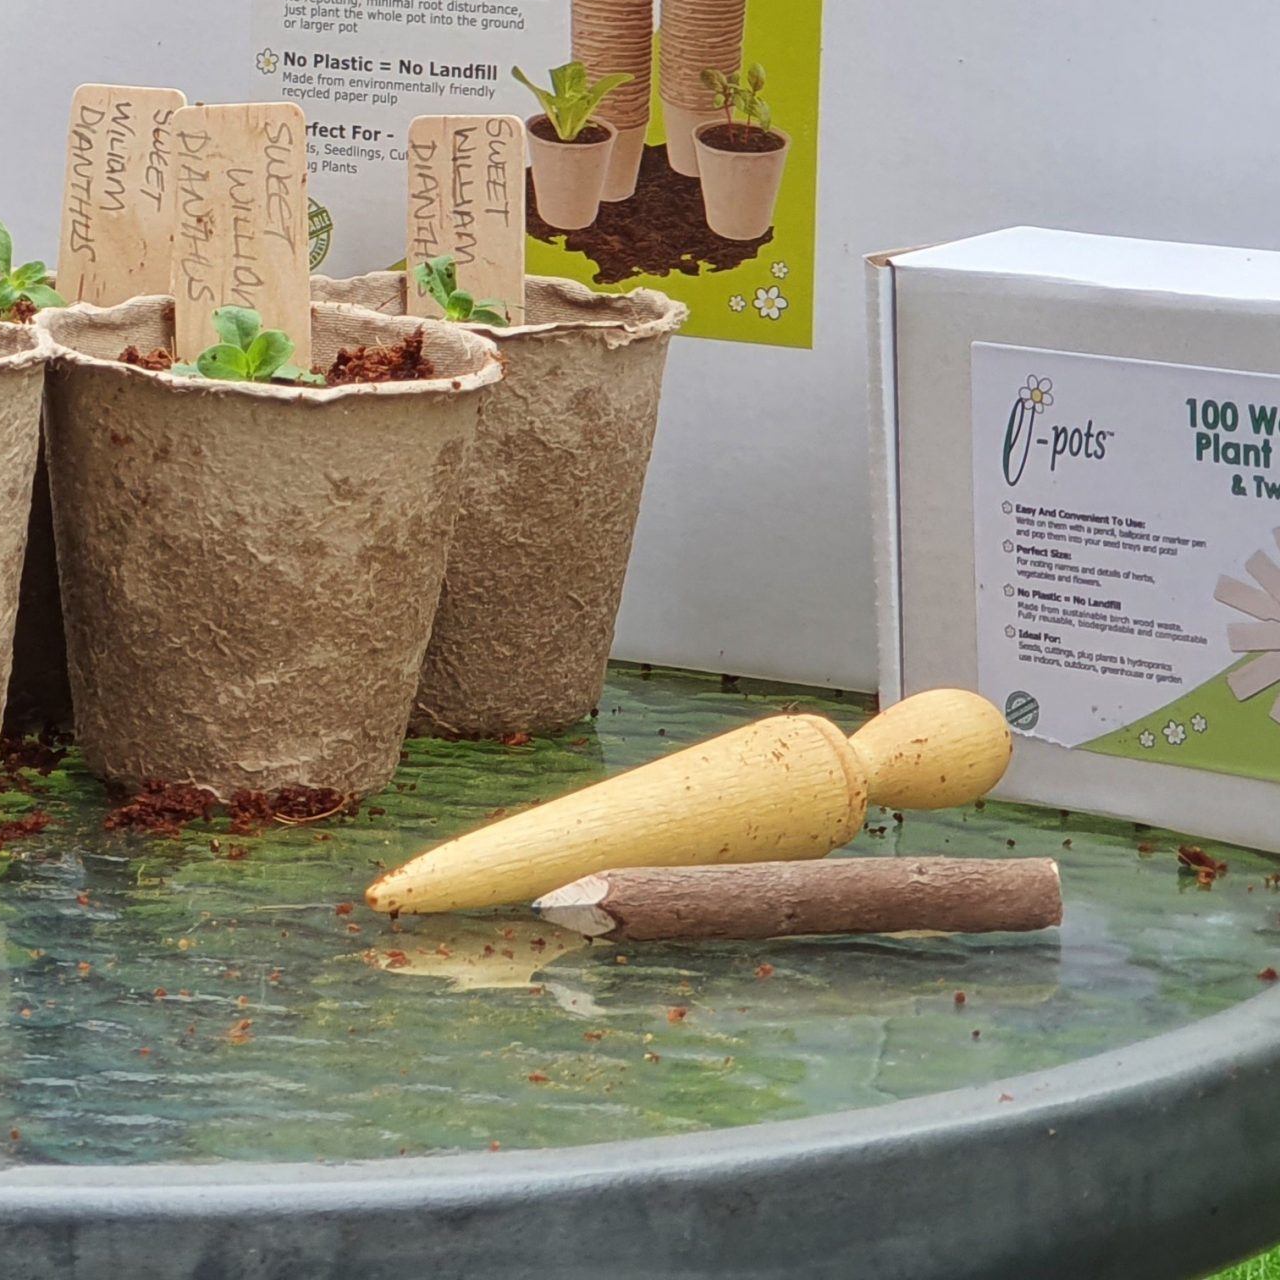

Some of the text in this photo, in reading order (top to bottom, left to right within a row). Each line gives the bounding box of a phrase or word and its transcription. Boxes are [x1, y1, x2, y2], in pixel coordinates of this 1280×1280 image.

[283, 4, 525, 30] just plant the whole pot into the ground
[418, 0, 443, 11] root
[446, 0, 522, 17] disturbance,
[283, 18, 358, 34] or larger pot
[283, 51, 497, 81] No Plastic = No Landfill
[281, 87, 398, 106] recycled paper pulp
[282, 71, 495, 100] Made from environmentally friendly
[304, 121, 347, 140] rfect
[351, 125, 382, 142] For
[140, 108, 174, 212] SWEET
[324, 143, 386, 161] Seedlings,
[321, 160, 359, 175] Plants
[484, 119, 514, 228] SWEET
[68, 105, 106, 263] DIANTHUS
[263, 122, 297, 255] SWEET
[176, 130, 215, 301] DIANTHUS
[411, 140, 439, 297] DIANTH
[1185, 398, 1239, 433] 100
[1196, 431, 1273, 469] Plant
[1231, 473, 1248, 497] &
[1015, 503, 1037, 517] Easy
[1038, 506, 1057, 518] And
[1058, 509, 1110, 522] Convenient
[1111, 515, 1124, 527] To
[1016, 544, 1048, 557] Perfect
[1017, 587, 1030, 598] No
[1031, 589, 1062, 602] Plastic
[1072, 595, 1086, 606] No
[1087, 597, 1121, 611] Landfill
[1018, 628, 1042, 641] Ideal
